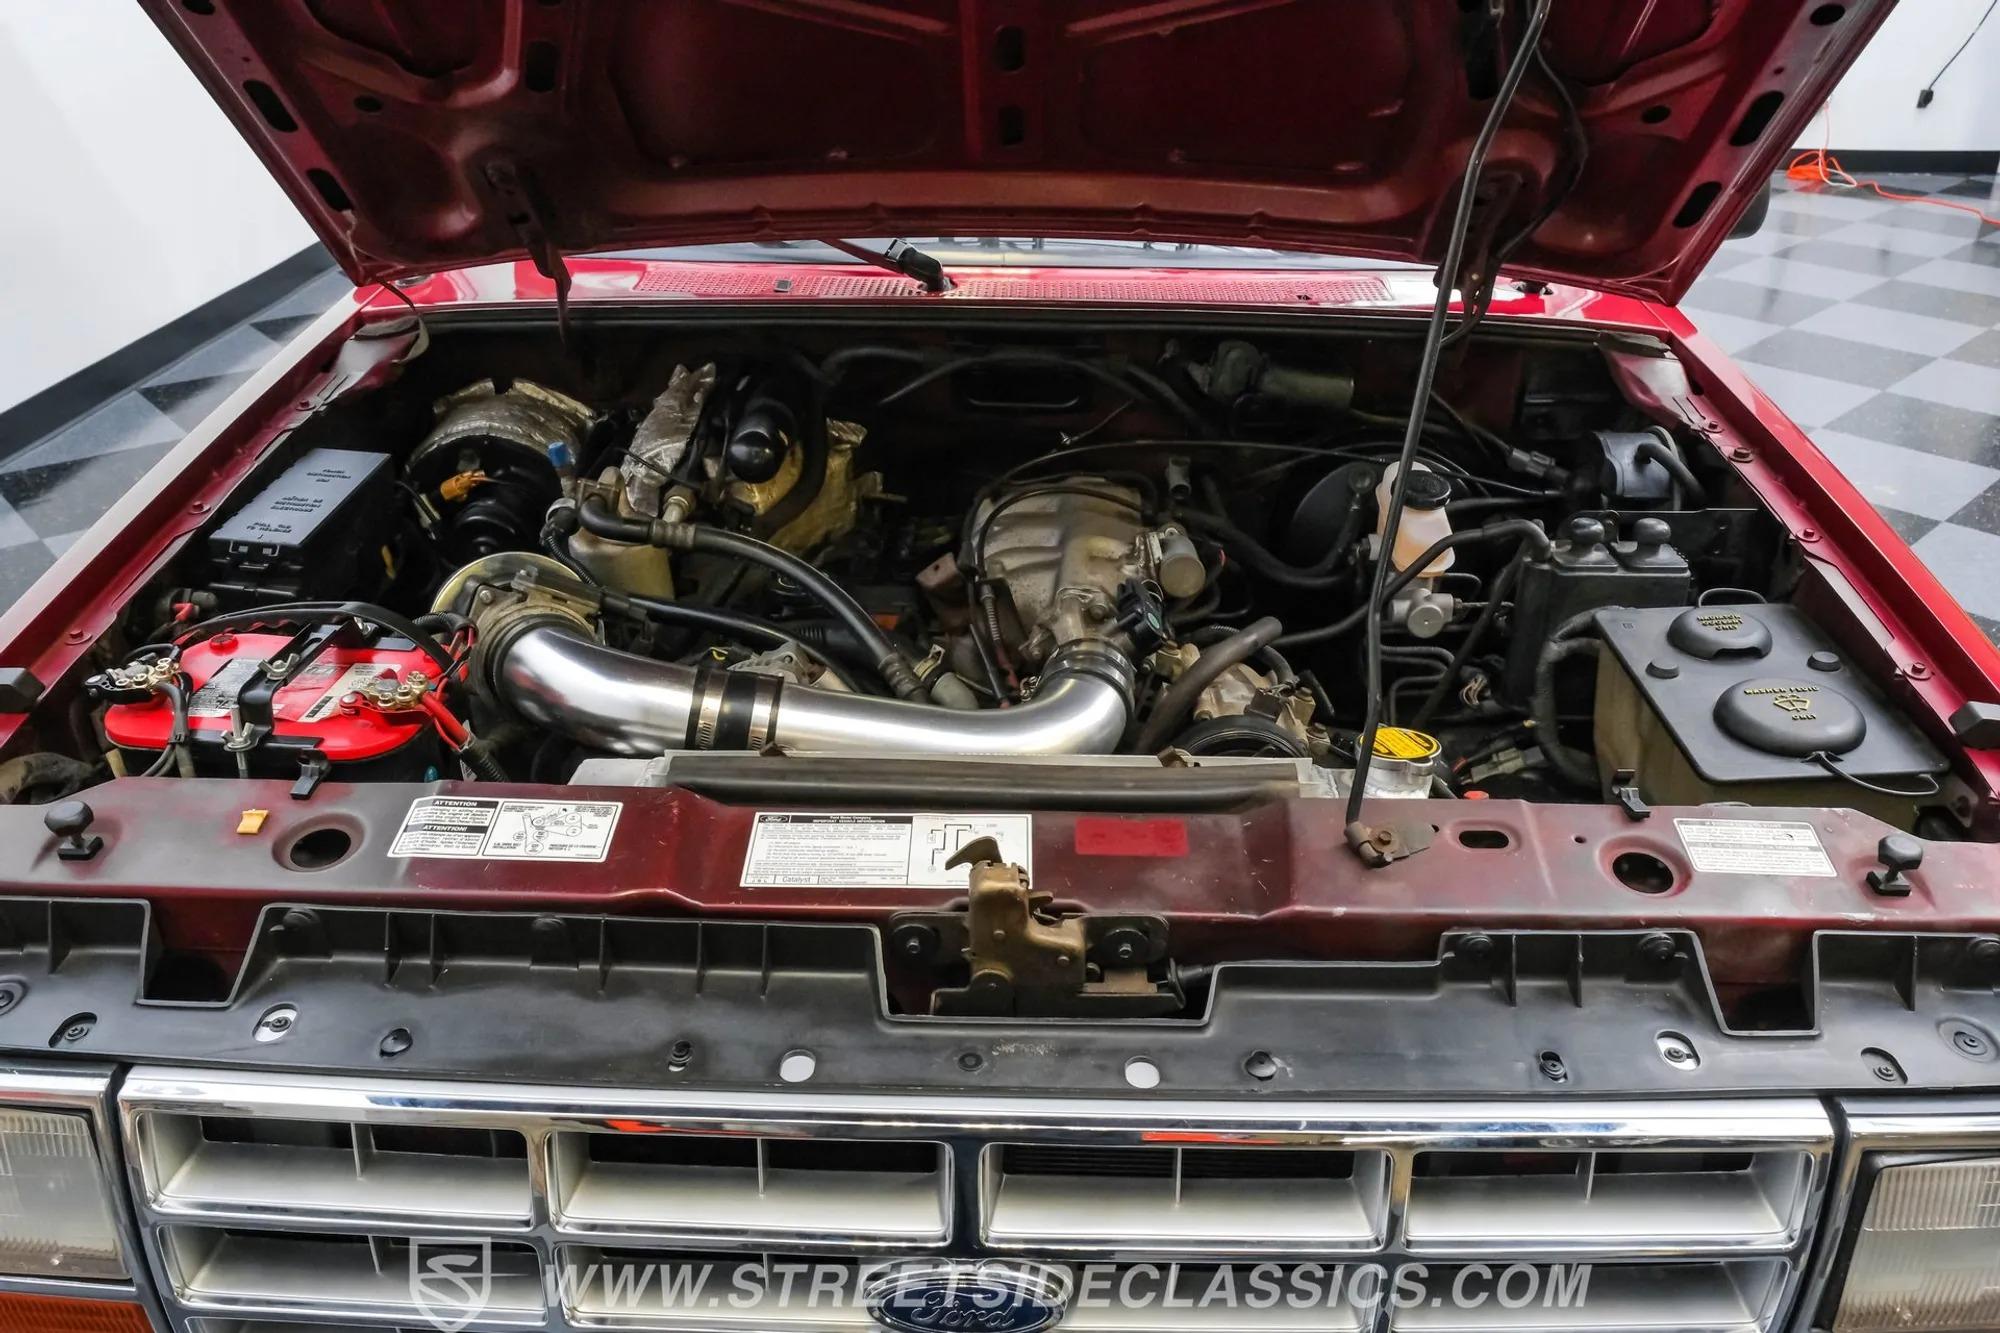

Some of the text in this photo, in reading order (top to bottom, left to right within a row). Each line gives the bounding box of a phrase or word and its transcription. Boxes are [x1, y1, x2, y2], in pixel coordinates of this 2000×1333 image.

[1743, 687, 1787, 695] WASHER
[422, 824, 468, 832] ATTENTION!
[782, 876, 811, 884] Catalyst
[910, 1290, 1016, 1329] Ford
